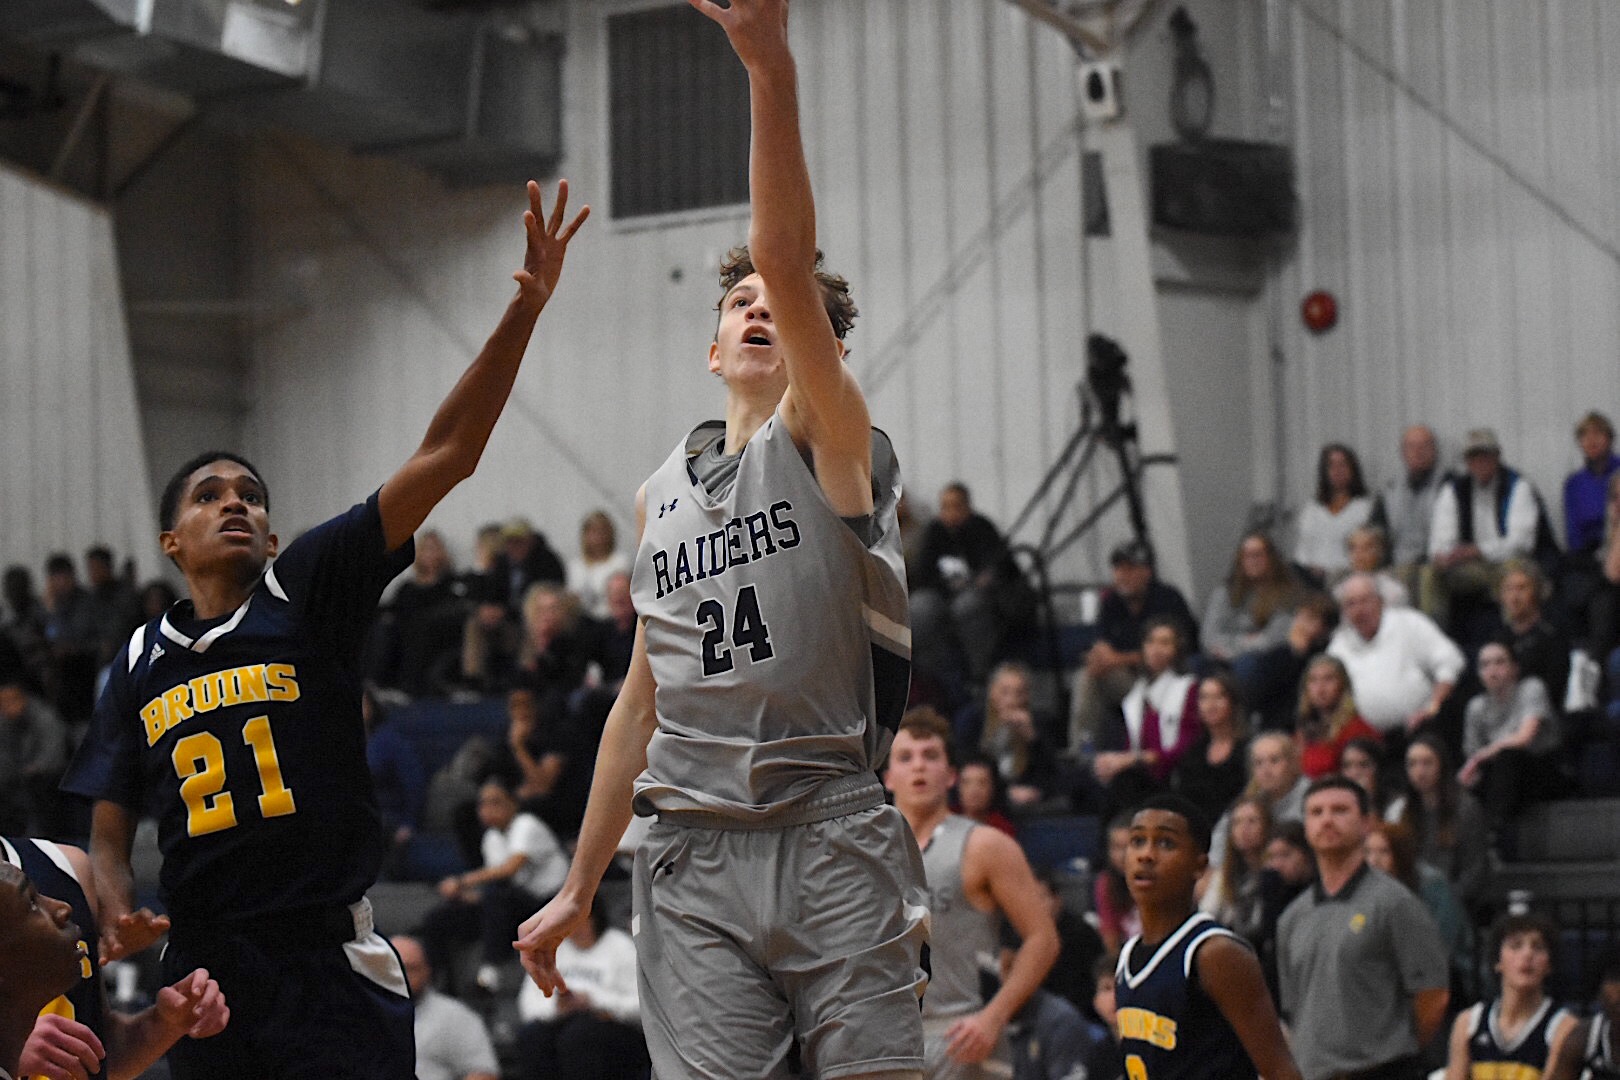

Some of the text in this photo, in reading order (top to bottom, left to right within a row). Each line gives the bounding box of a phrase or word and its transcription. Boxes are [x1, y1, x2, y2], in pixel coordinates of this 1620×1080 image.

[652, 500, 801, 600] RAIDERS
[695, 582, 777, 678] 24
[139, 662, 301, 748] BRUINS
[171, 715, 297, 838] 21
